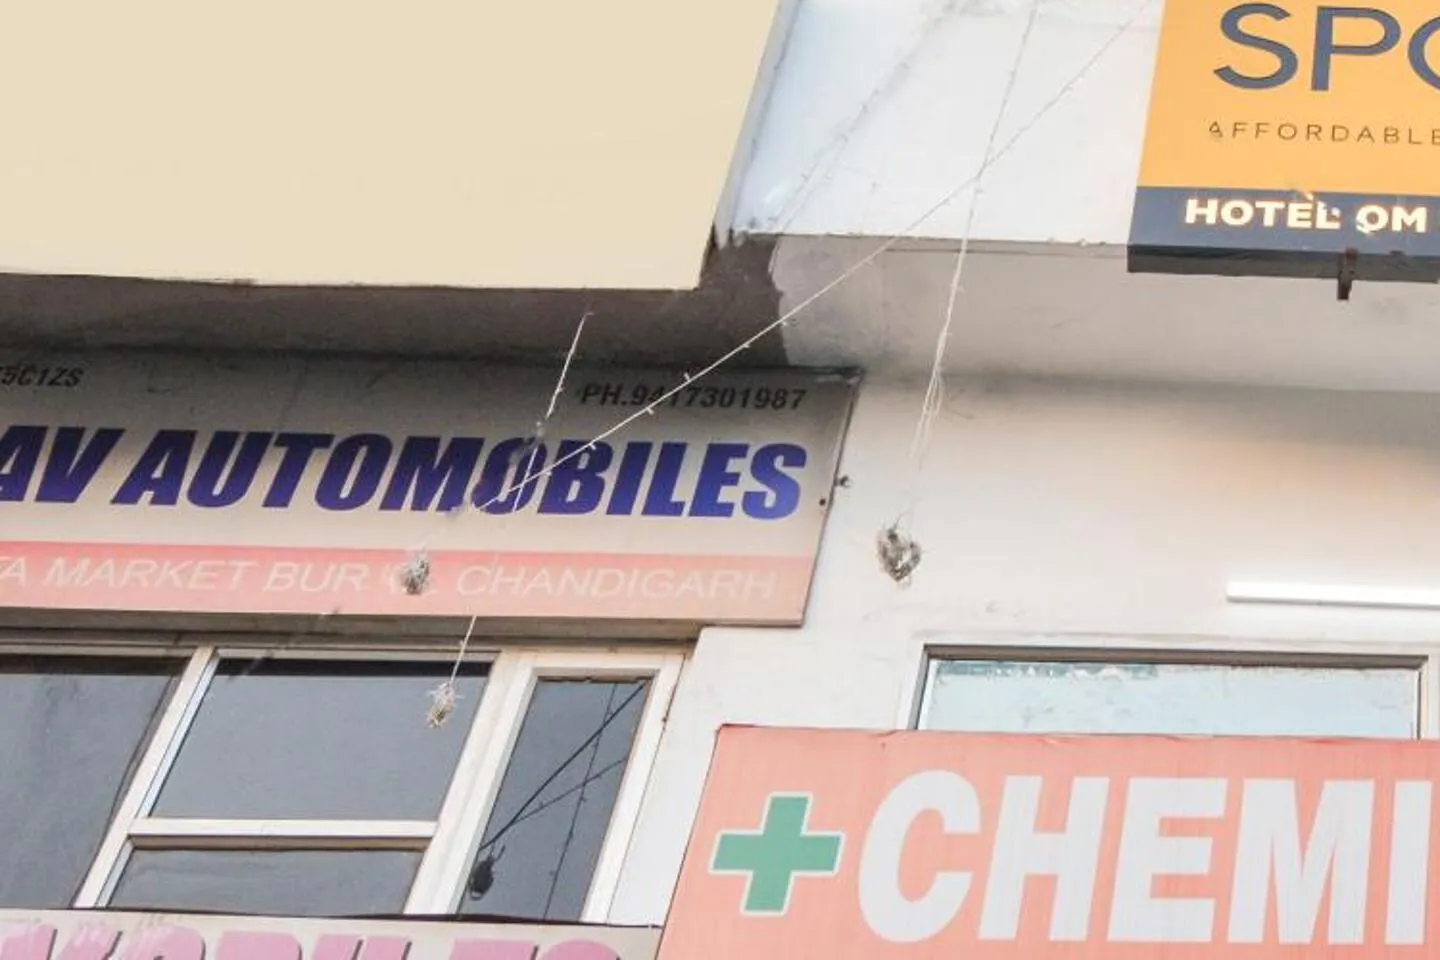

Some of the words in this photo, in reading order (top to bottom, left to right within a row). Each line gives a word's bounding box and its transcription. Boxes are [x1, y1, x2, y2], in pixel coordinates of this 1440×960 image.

[1356, 204, 1428, 238] OM
[0, 425, 125, 504] AV
[109, 429, 807, 520] AUTOMOBILES
[41, 557, 254, 591] MARKET
[456, 564, 779, 601] CHANDIGARH
